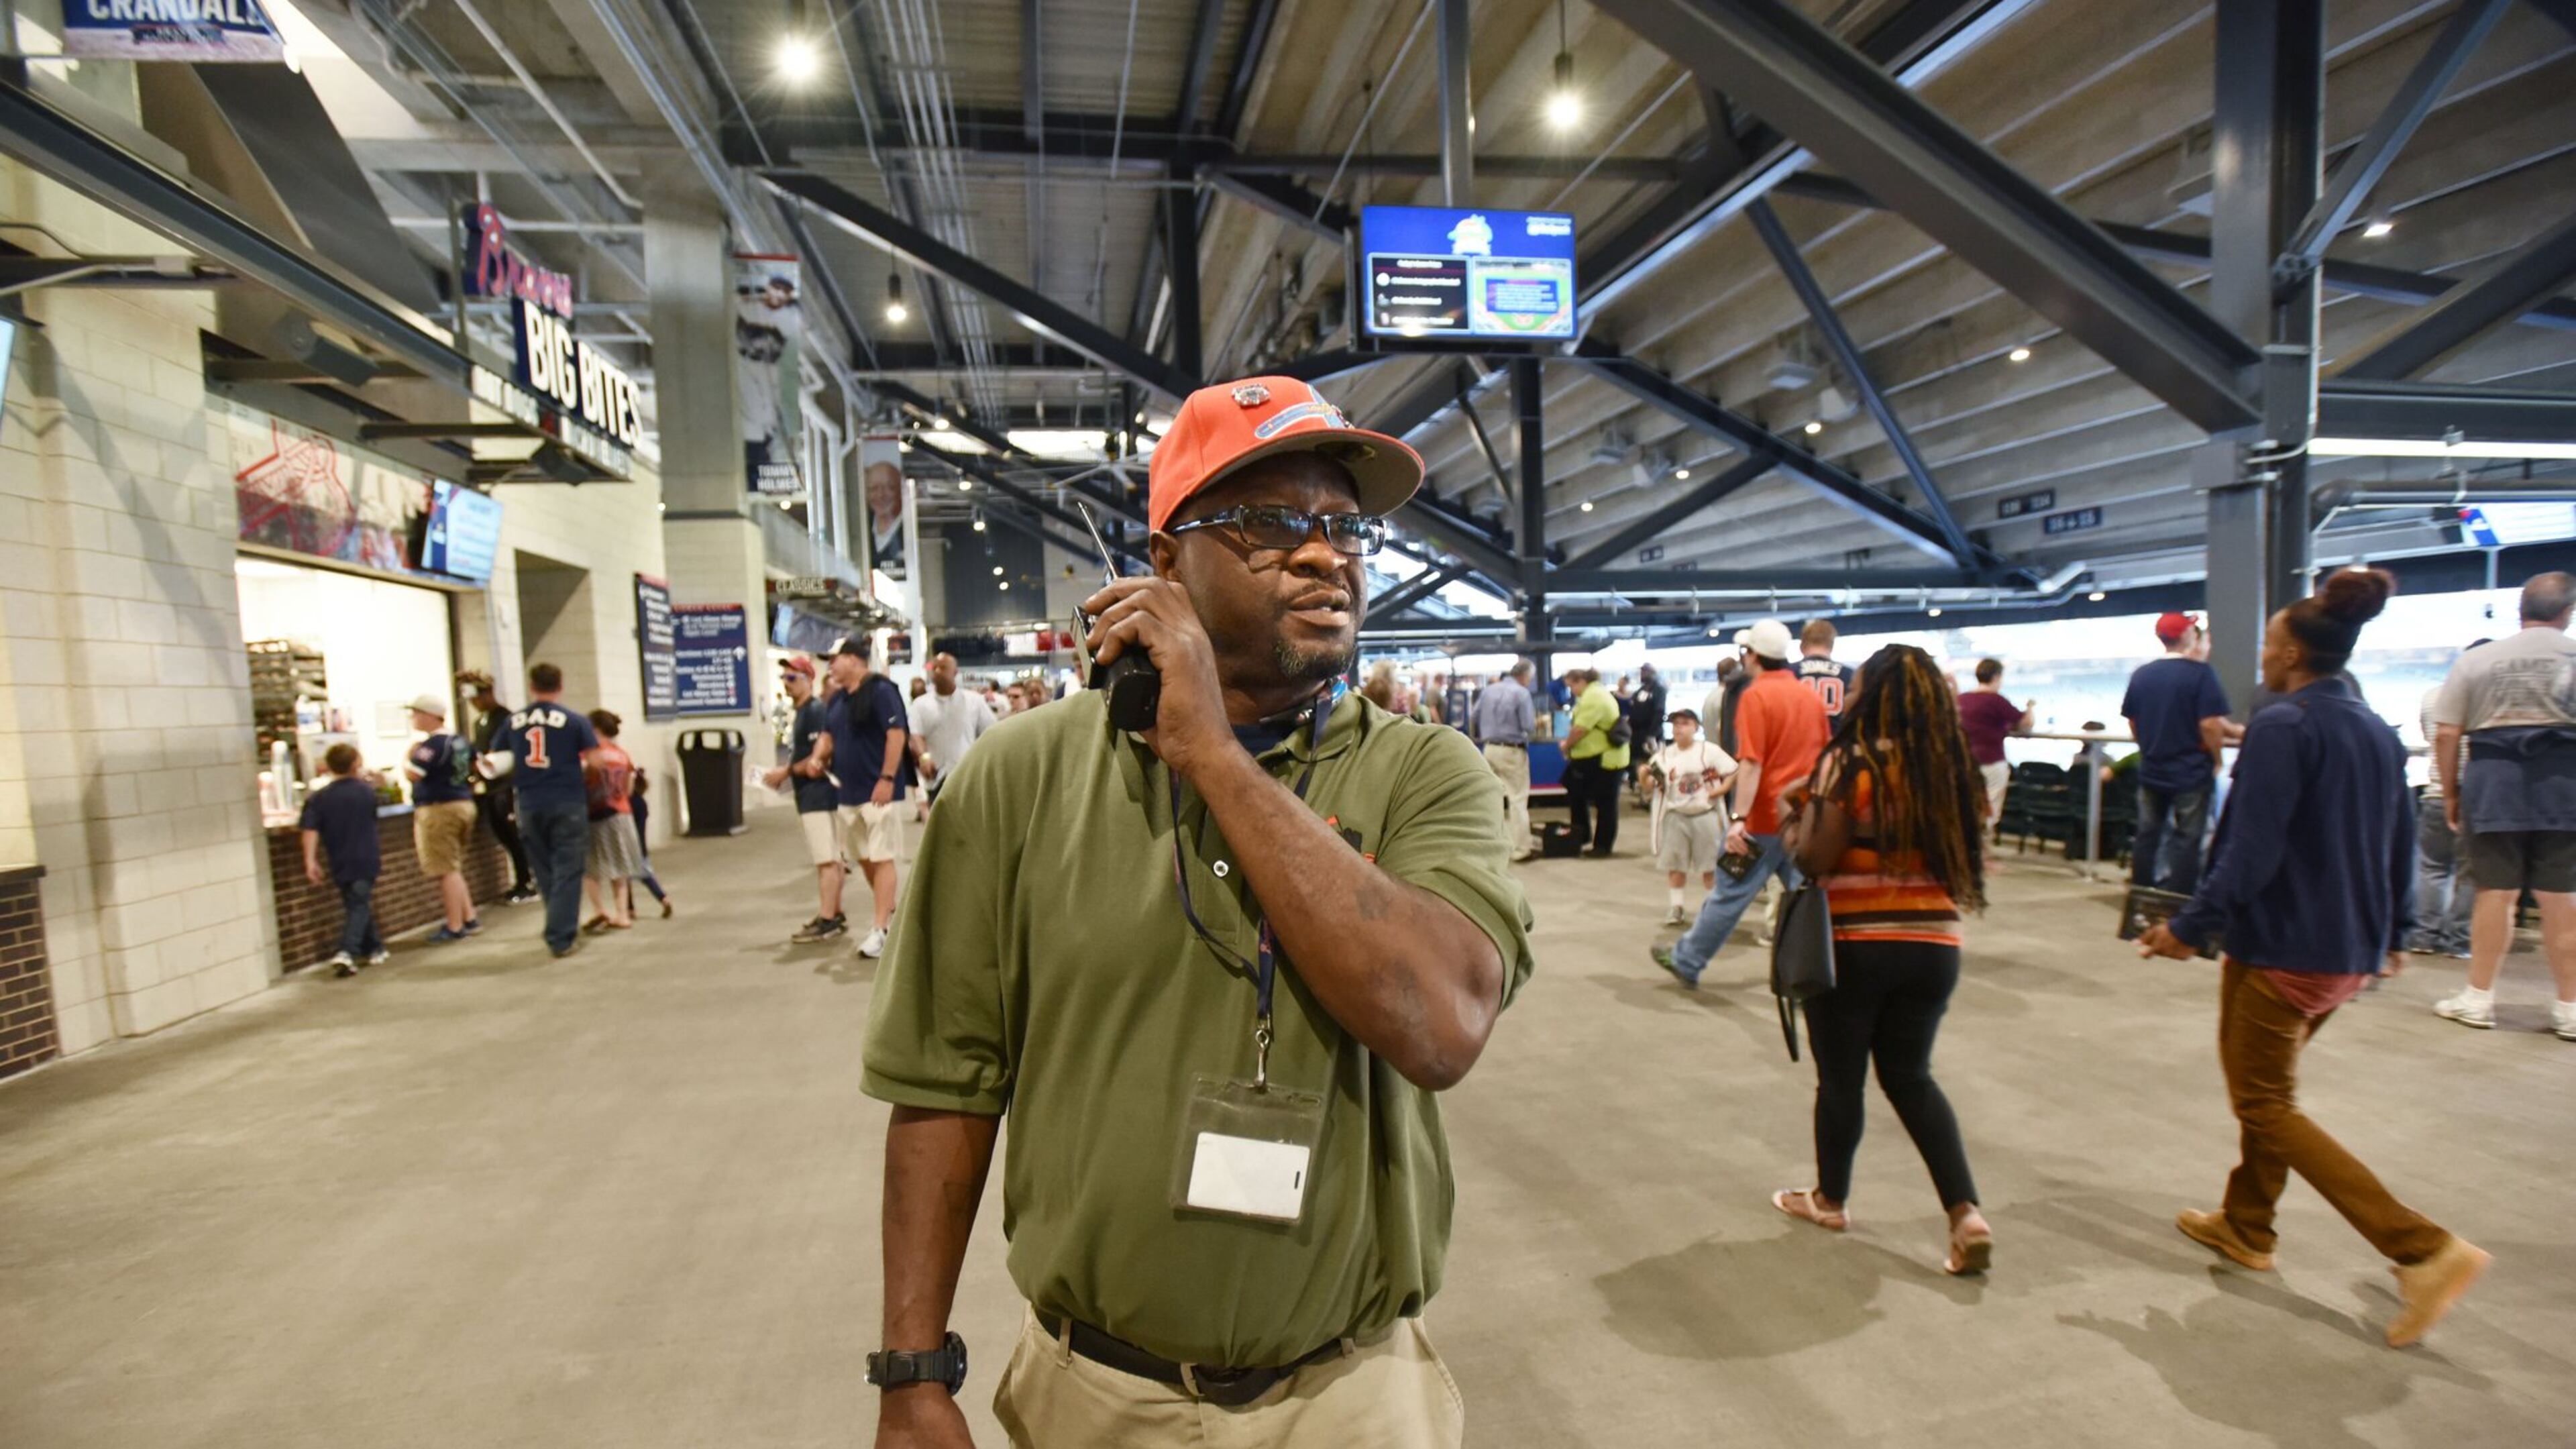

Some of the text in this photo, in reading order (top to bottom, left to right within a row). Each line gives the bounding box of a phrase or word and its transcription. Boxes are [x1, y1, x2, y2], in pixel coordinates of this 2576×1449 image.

[524, 300, 577, 409] BIG
[578, 340, 643, 450] BITES
[775, 578, 824, 592] CLASSICS
[511, 708, 567, 731] DAD
[525, 727, 551, 769] 1
